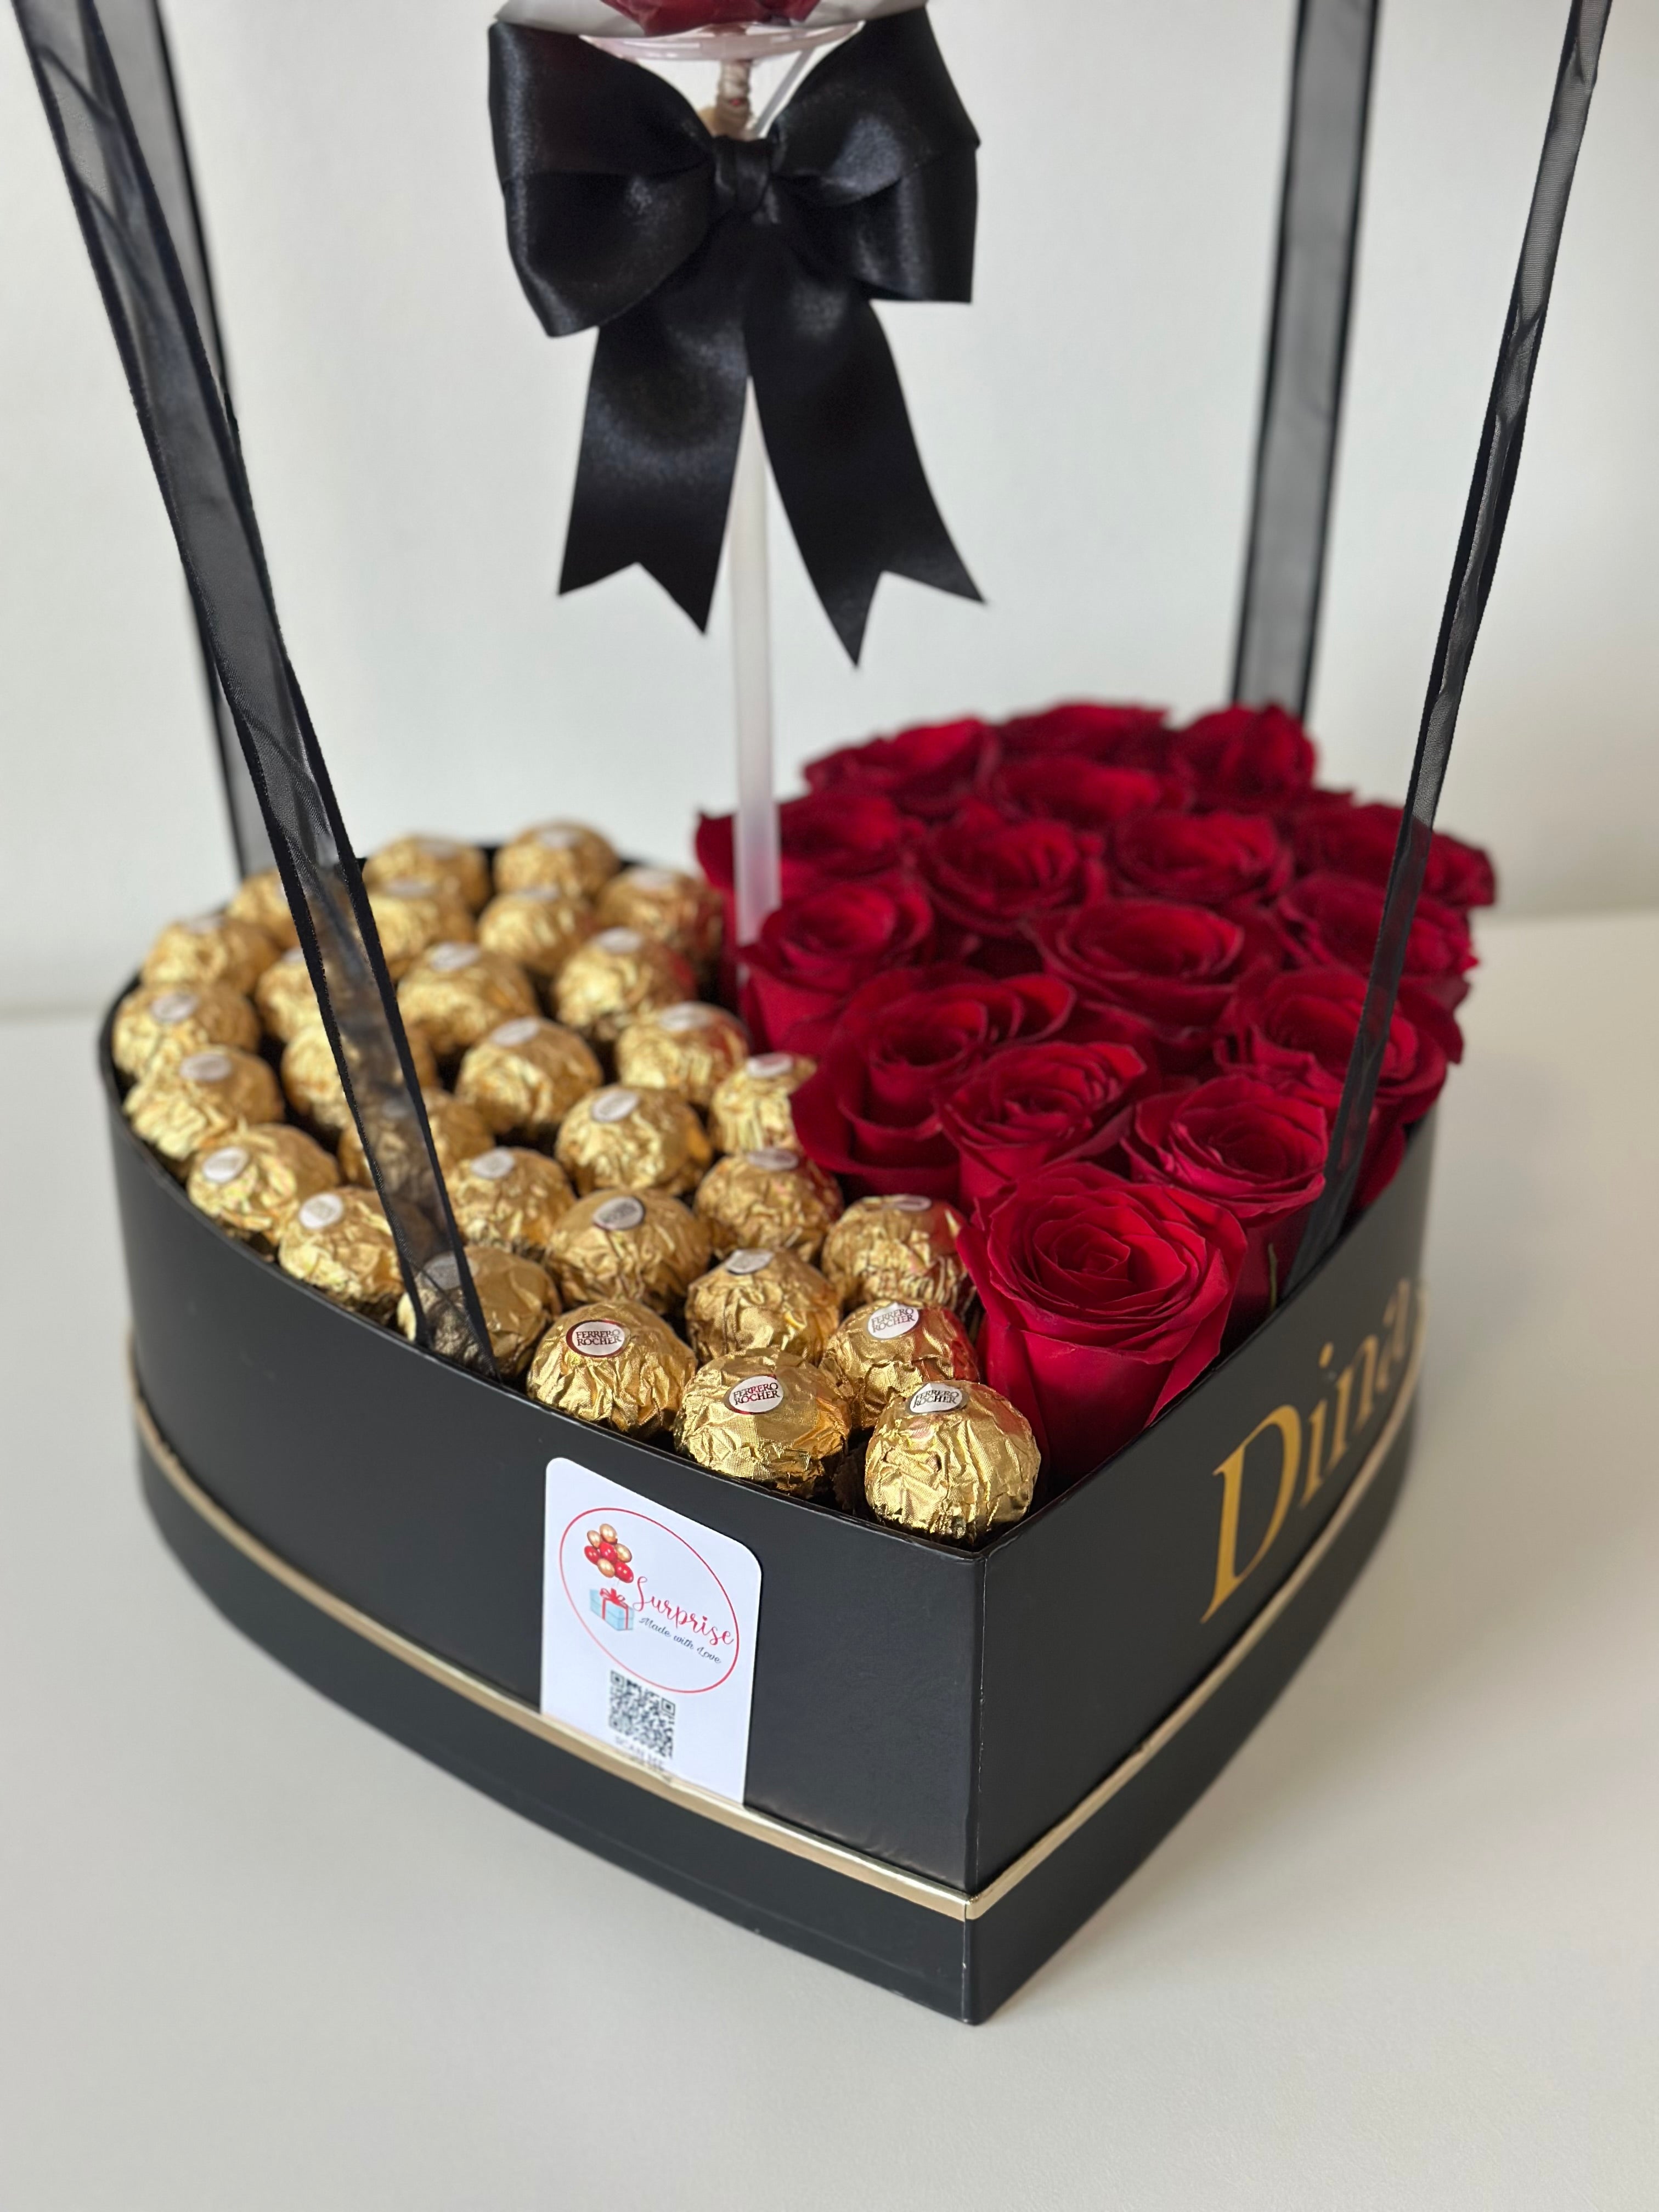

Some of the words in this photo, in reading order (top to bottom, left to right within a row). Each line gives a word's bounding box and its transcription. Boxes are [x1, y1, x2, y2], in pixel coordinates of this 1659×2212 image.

[871, 1308, 914, 1326] FERRERO
[872, 1314, 916, 1333] ROCHER
[575, 1329, 620, 1338] FERRERO
[577, 1336, 622, 1346] ROCHER
[733, 1383, 778, 1398] FERRERO
[735, 1390, 780, 1405] ROCHER
[633, 1576, 734, 1645] Surprise
[639, 1617, 672, 1637] Made
[674, 1635, 693, 1649] with
[697, 1647, 721, 1664] Love
